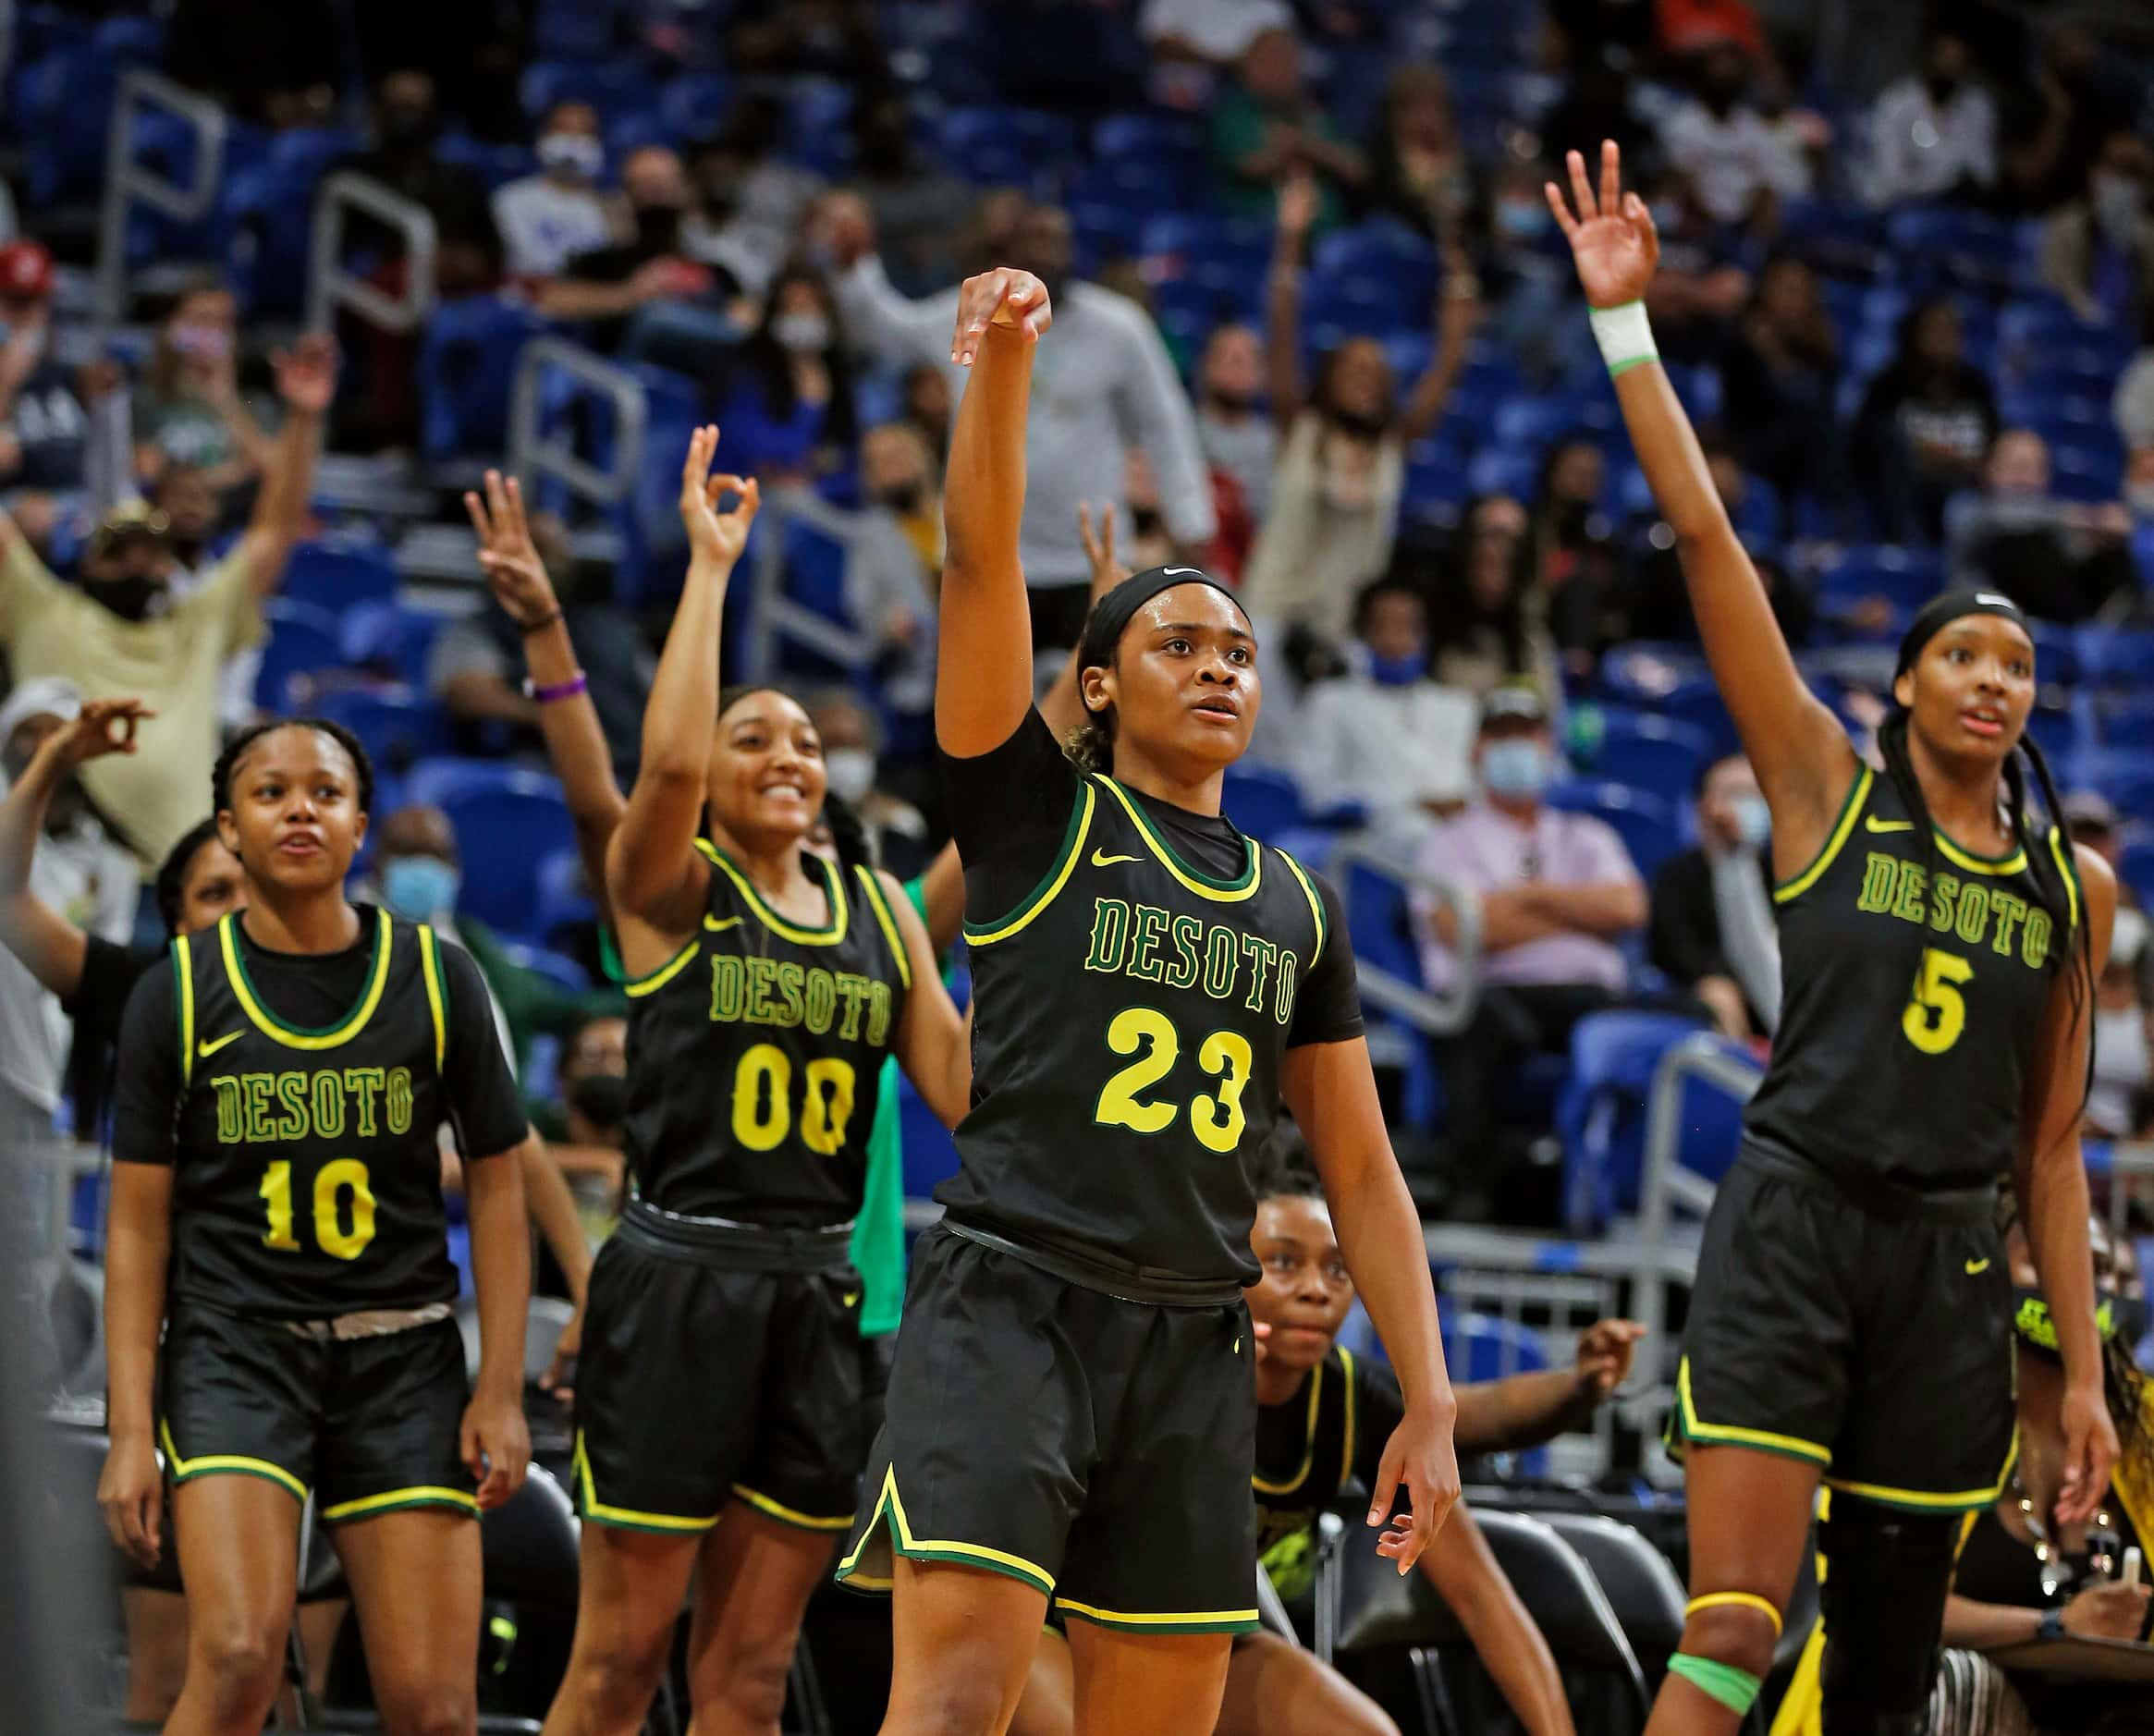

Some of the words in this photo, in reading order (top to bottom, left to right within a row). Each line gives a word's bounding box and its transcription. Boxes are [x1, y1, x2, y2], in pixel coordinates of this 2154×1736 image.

[1084, 897, 1297, 1025] DESOTO
[1856, 850, 2052, 970] DESOTO
[709, 954, 892, 1047] DESOTO
[1902, 947, 1975, 1055] 5
[210, 1066, 414, 1143] DESOTO
[730, 1043, 856, 1155] 00
[1094, 1007, 1253, 1153] 23
[258, 1157, 378, 1261] 10
